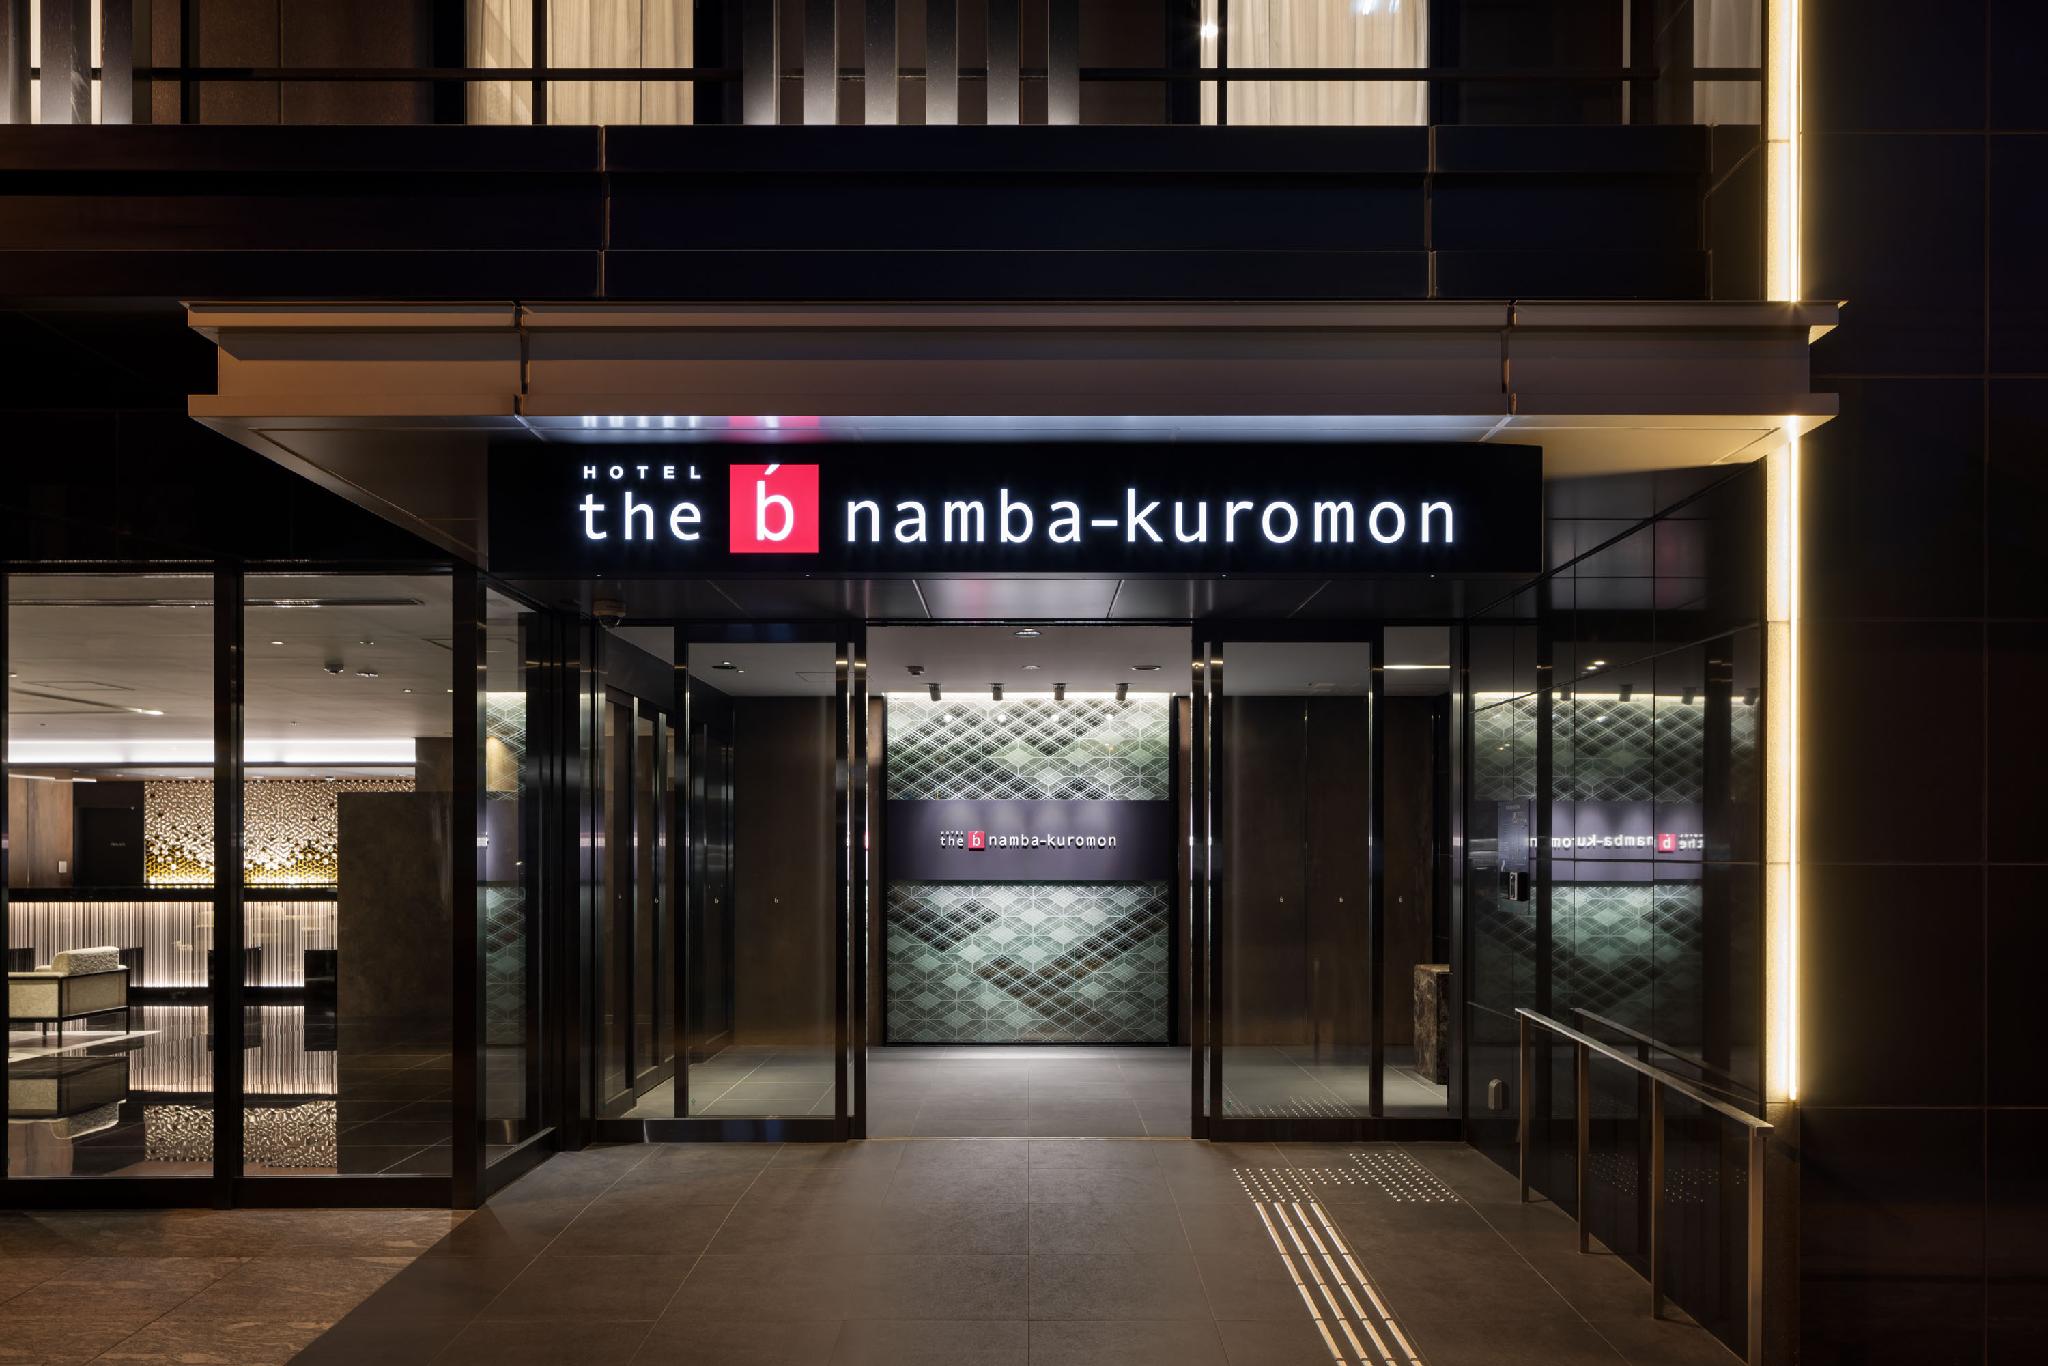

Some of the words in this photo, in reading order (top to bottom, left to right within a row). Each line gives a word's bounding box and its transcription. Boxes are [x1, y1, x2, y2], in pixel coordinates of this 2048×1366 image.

[583, 465, 701, 480] HOTEL
[579, 491, 702, 541] the
[847, 488, 1454, 544] namba-kuromon
[940, 835, 964, 847] the
[988, 833, 1116, 847] namba-kuromon
